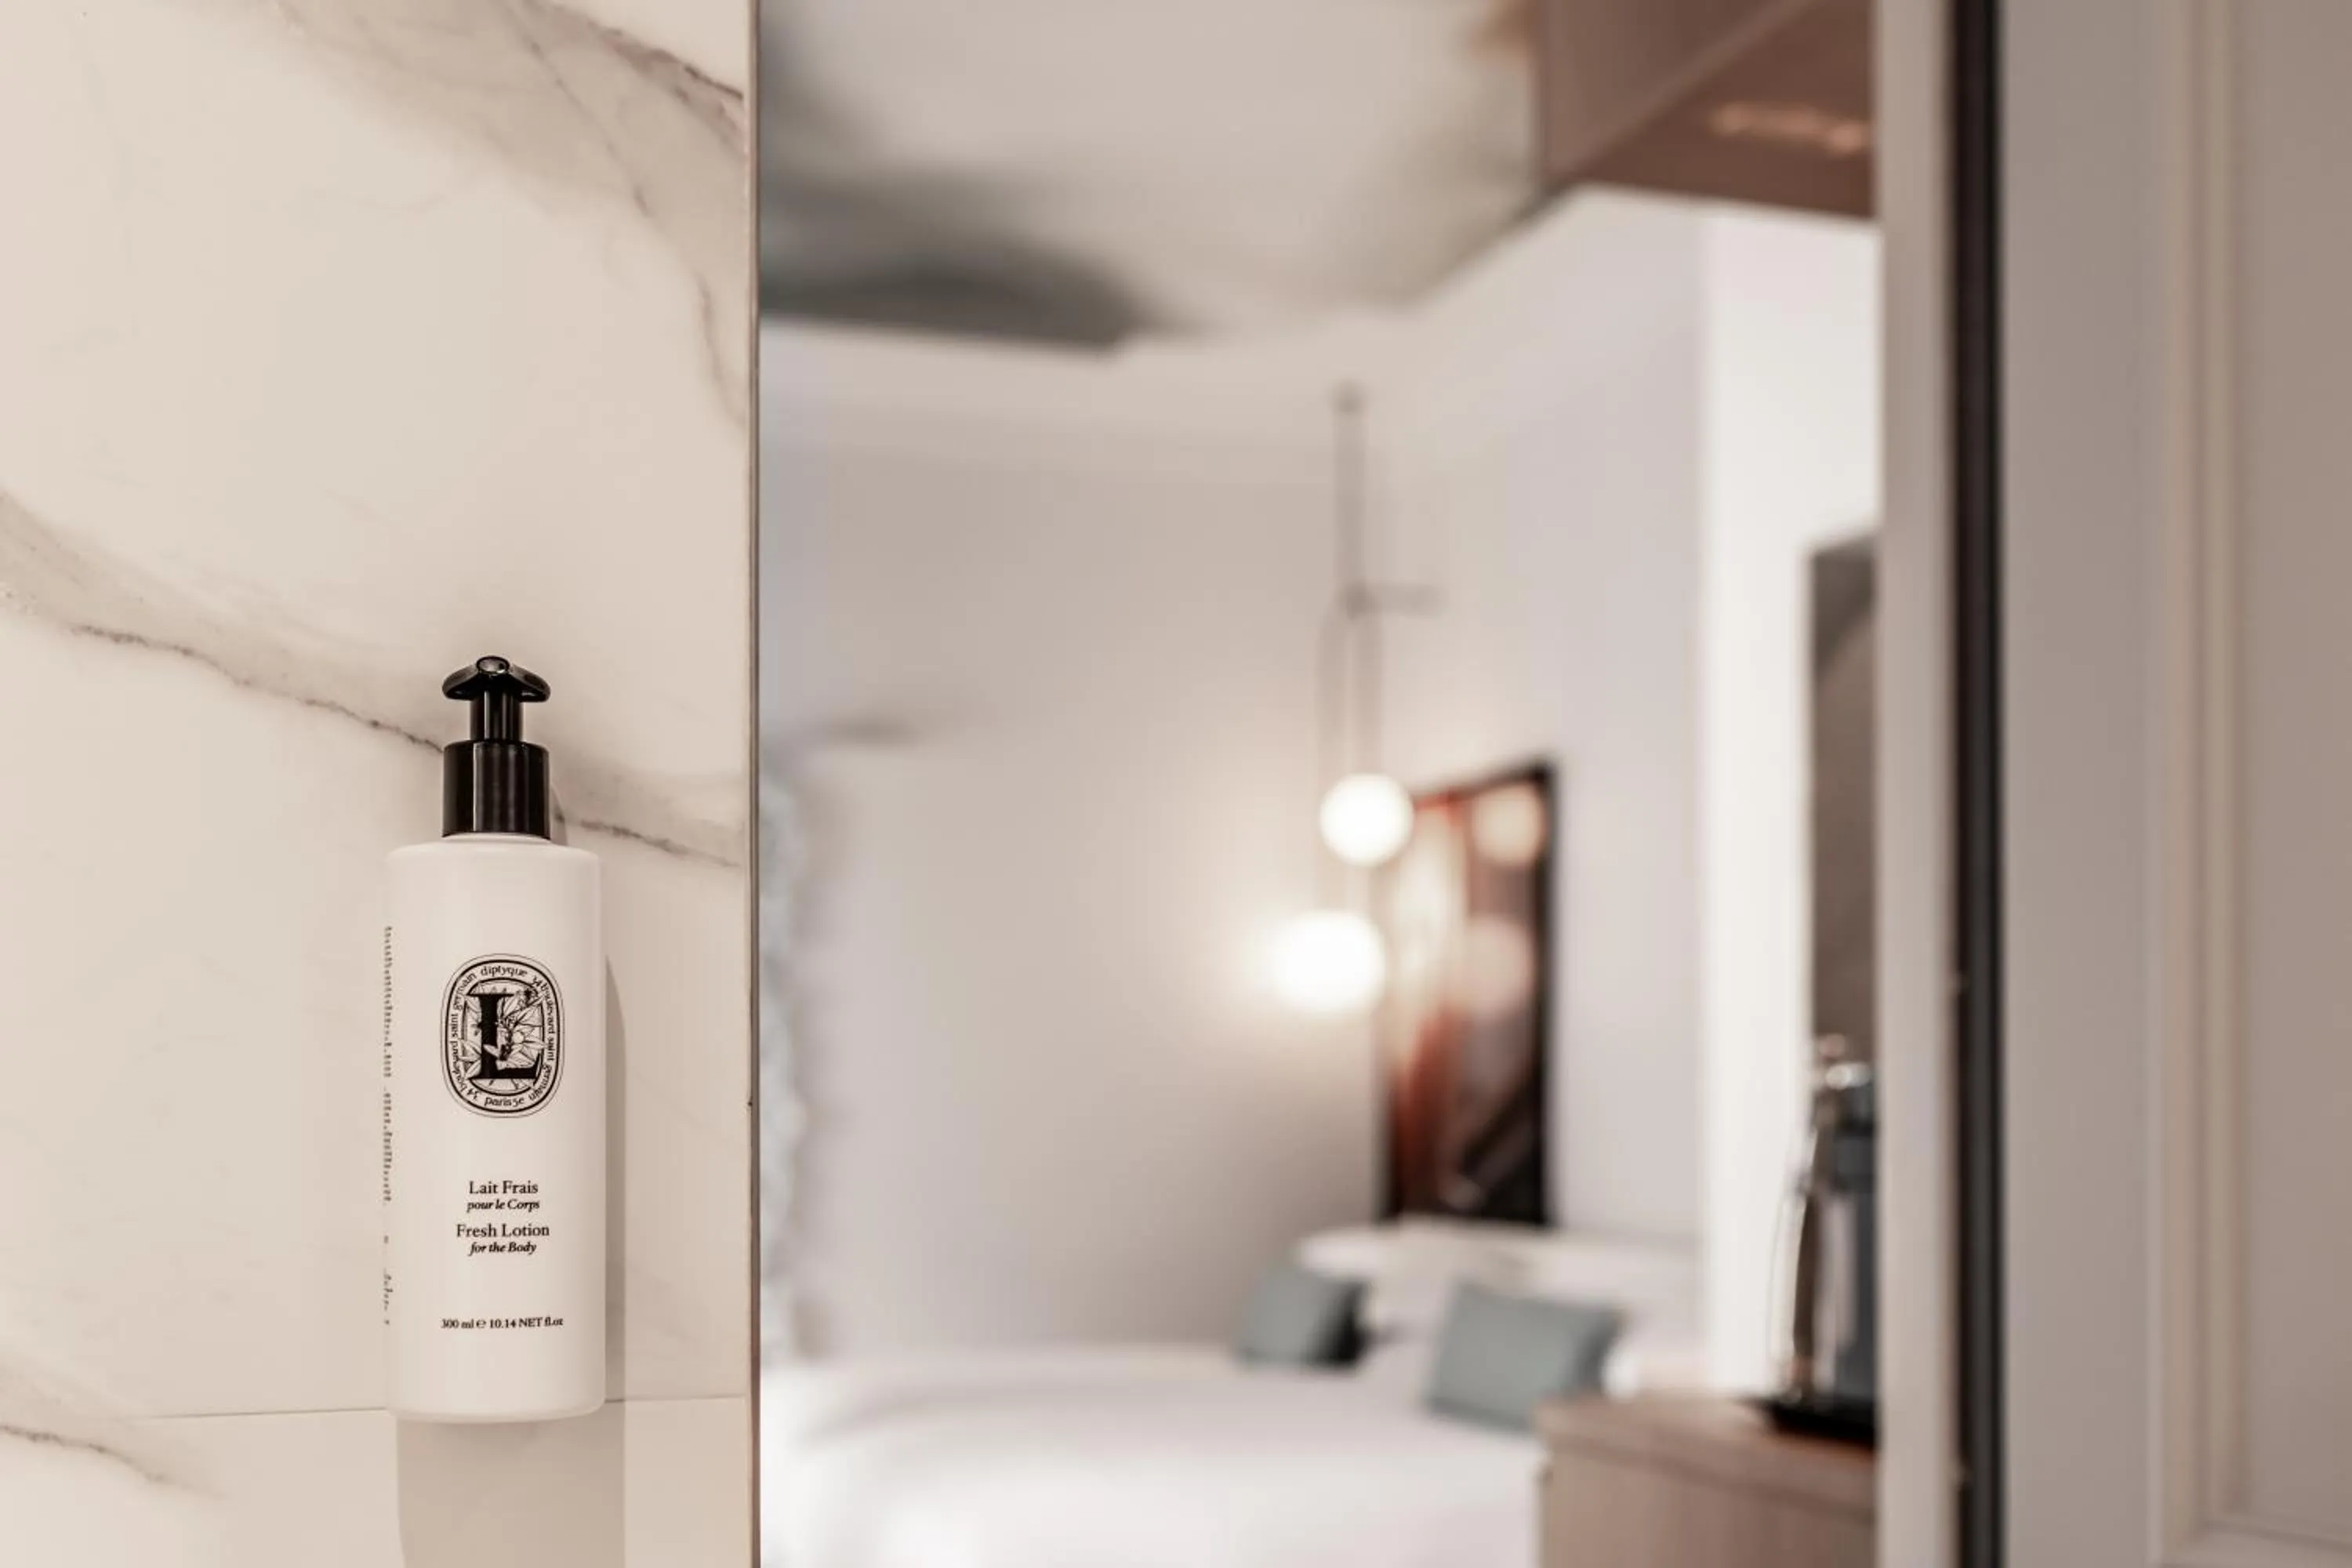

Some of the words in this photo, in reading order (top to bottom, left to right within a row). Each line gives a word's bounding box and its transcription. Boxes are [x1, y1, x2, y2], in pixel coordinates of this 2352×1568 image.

[480, 965, 528, 978] diptyque
[450, 1014, 459, 1039] saint
[546, 1038, 556, 1062] saint
[528, 1063, 553, 1102] germain
[469, 1180, 499, 1194] Lait
[502, 1180, 539, 1194] Frais
[466, 1201, 494, 1213] pour
[495, 1199, 505, 1210] le
[507, 1199, 540, 1212] Corps
[456, 1223, 496, 1237] Fresh
[502, 1223, 550, 1237] Lotion
[468, 1241, 486, 1256] for
[489, 1241, 506, 1252] the
[508, 1241, 537, 1255] Body
[441, 1318, 459, 1329] 300
[461, 1319, 474, 1328] ml
[489, 1319, 517, 1328] 10.14
[518, 1316, 543, 1327] NET
